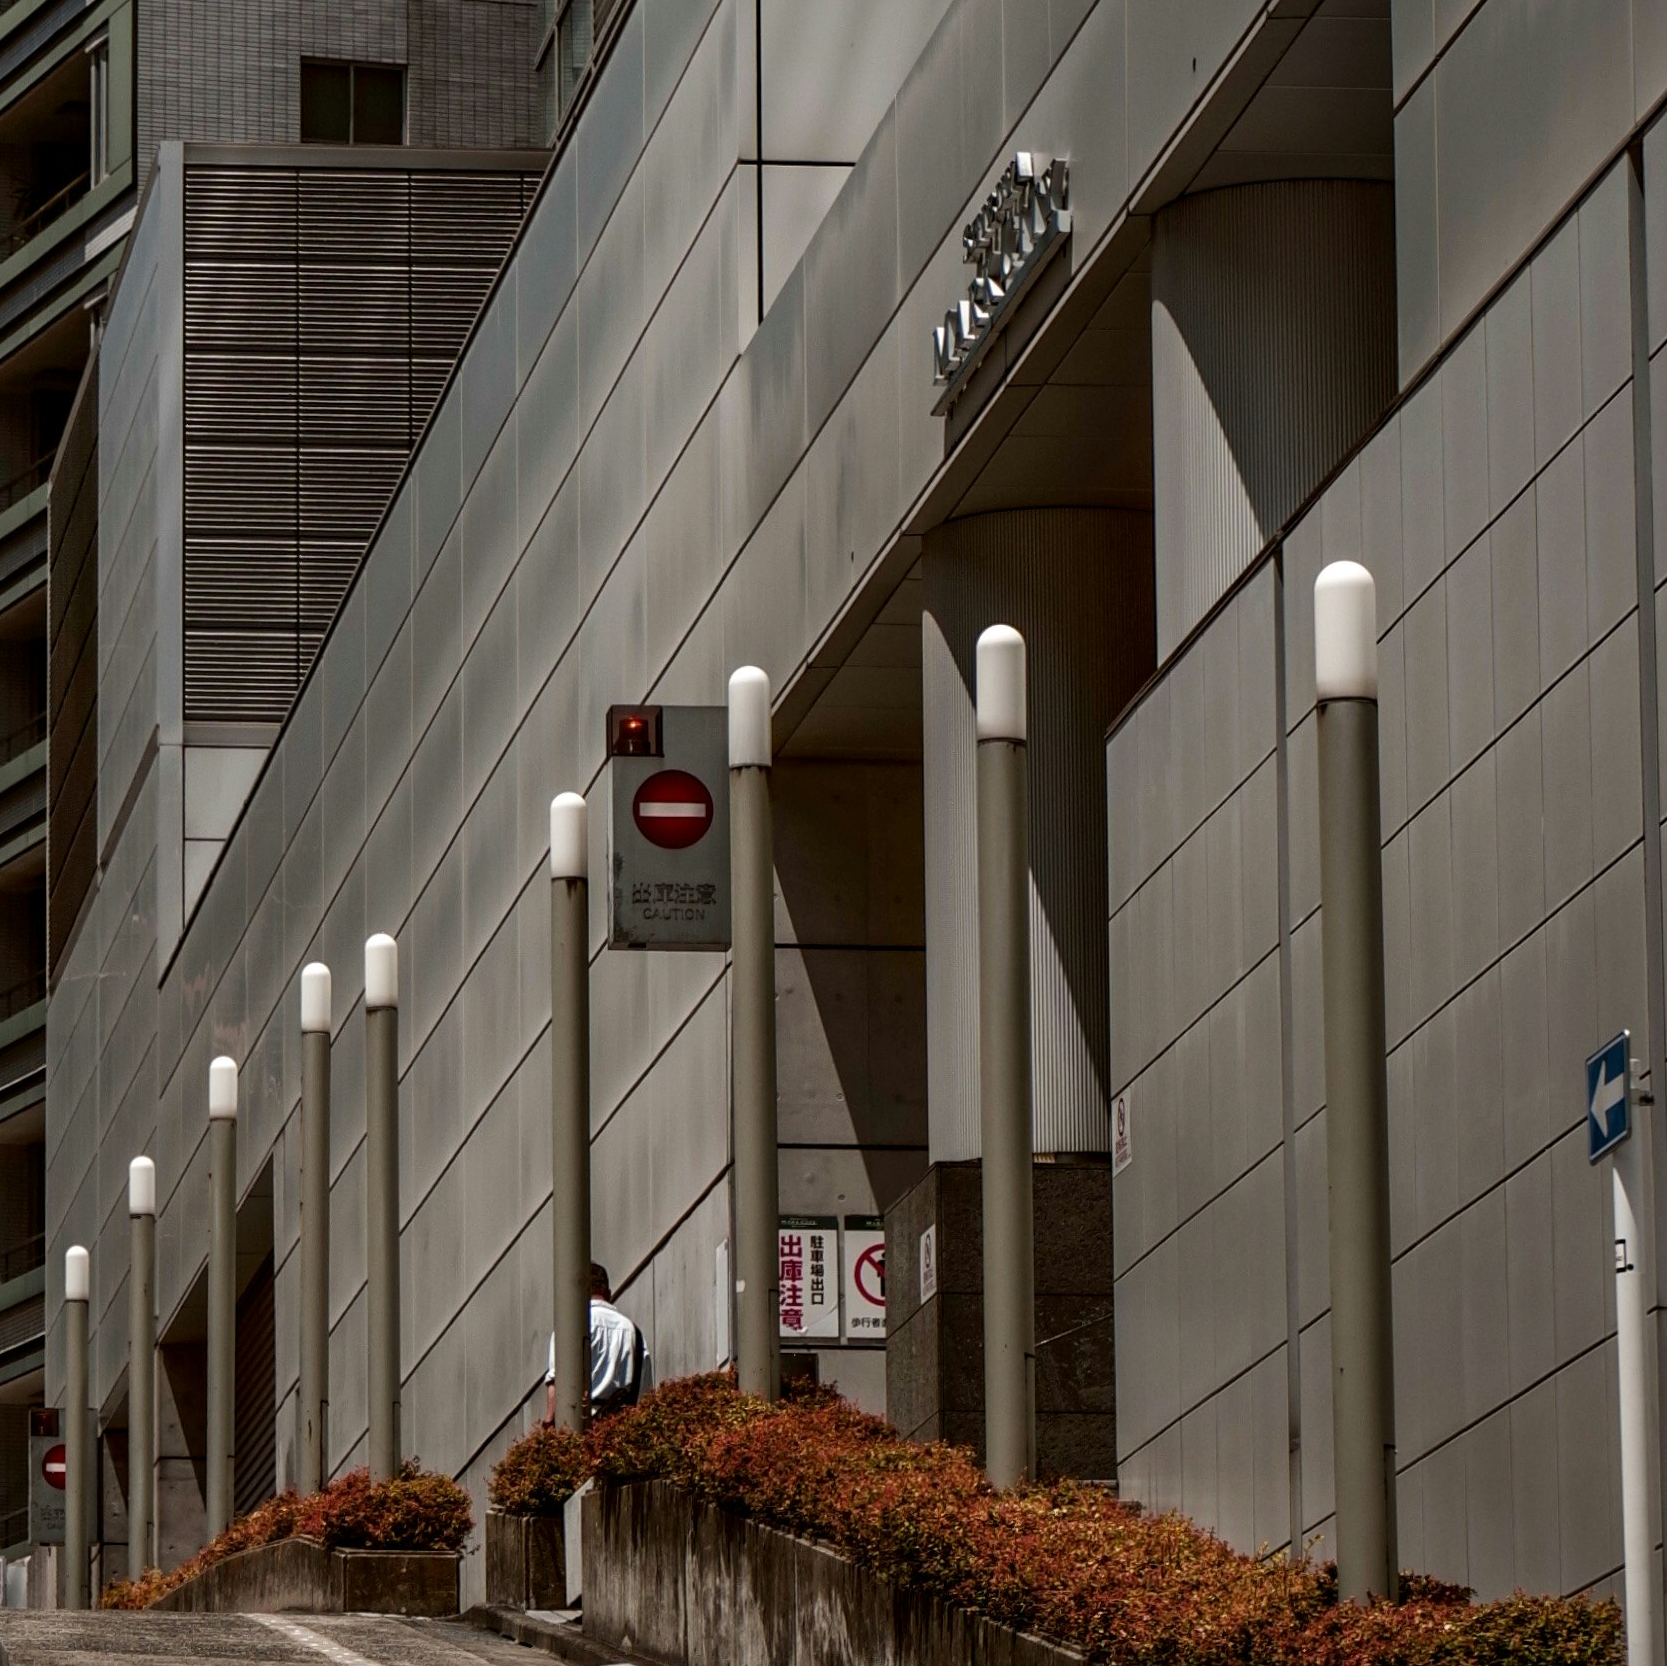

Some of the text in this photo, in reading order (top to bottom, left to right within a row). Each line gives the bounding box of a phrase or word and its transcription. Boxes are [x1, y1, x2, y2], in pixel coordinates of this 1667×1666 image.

[643, 907, 706, 921] CAUTION
[780, 1234, 804, 1331] 出庫注意
[810, 1235, 824, 1305] 駐車場出口
